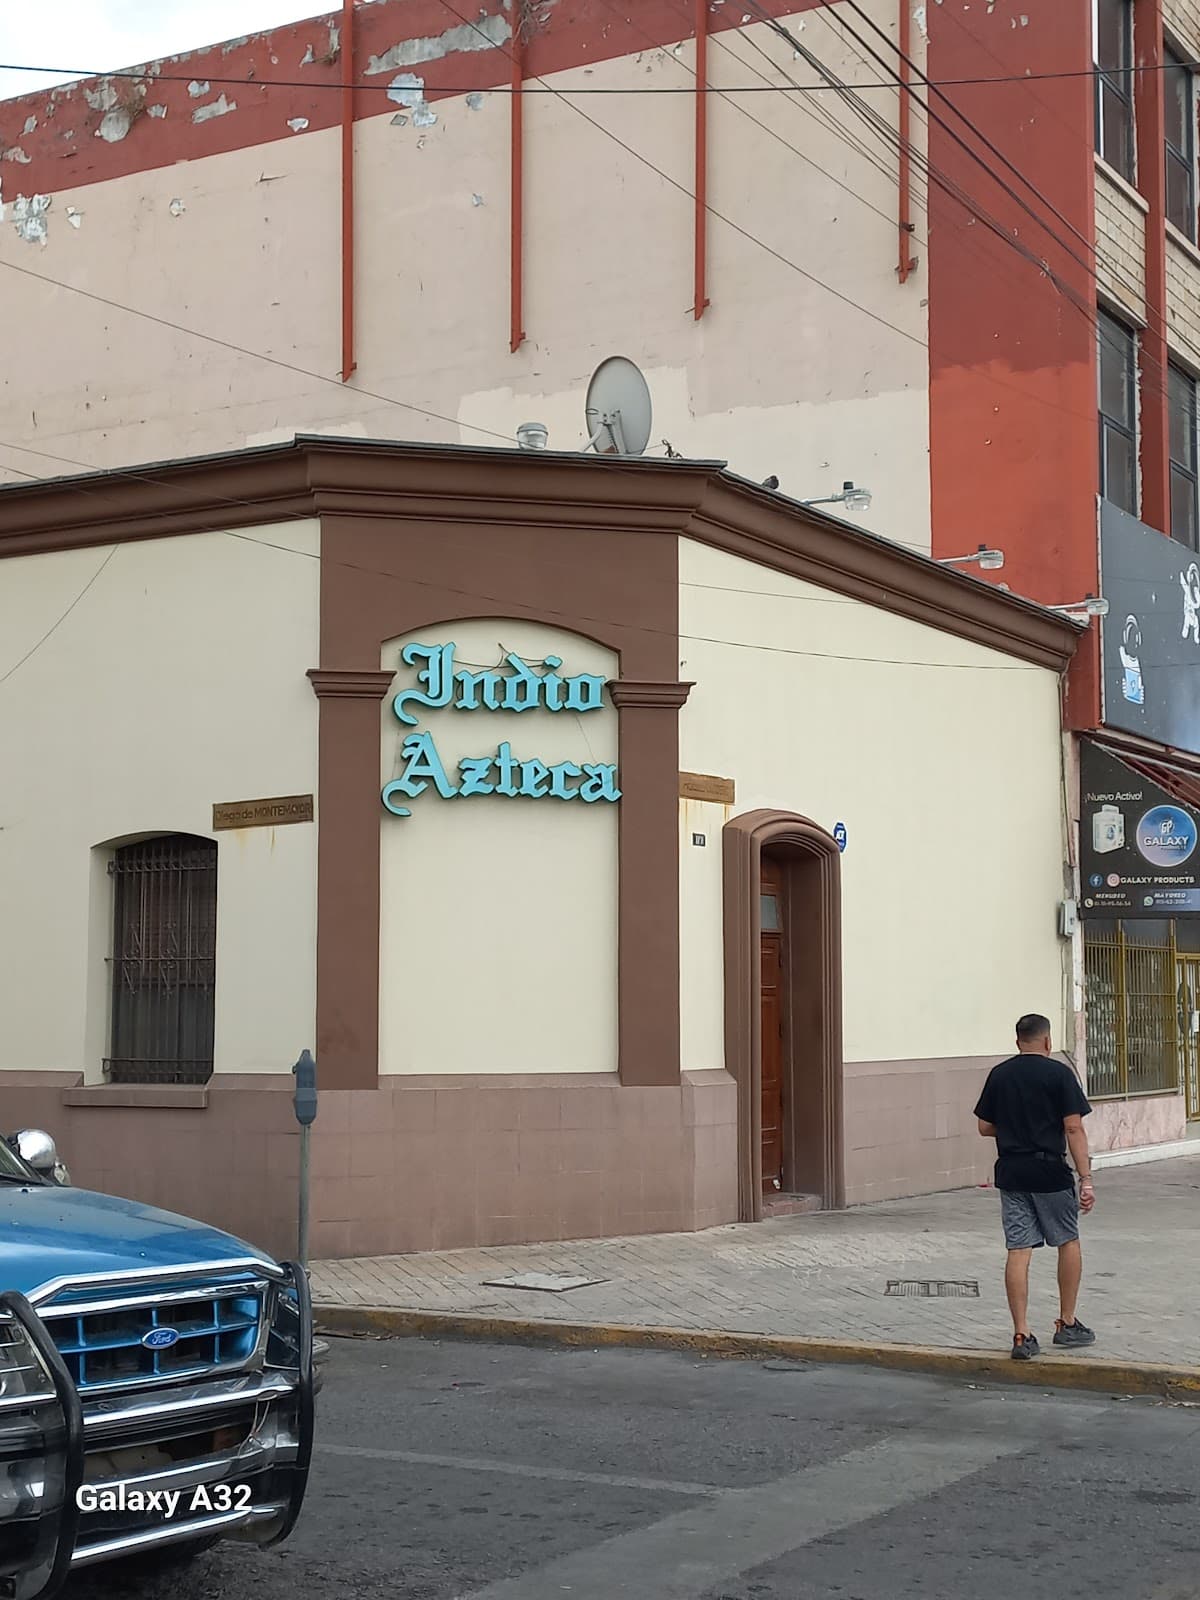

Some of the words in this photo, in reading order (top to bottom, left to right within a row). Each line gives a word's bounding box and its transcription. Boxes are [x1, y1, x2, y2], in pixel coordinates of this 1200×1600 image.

[393, 641, 606, 726] Indio
[382, 731, 622, 817] Azteca
[1115, 791, 1143, 801] Activo!
[1143, 836, 1189, 846] GALAXY
[1154, 876, 1195, 884] PRODUCTS
[151, 1331, 172, 1345] Ford
